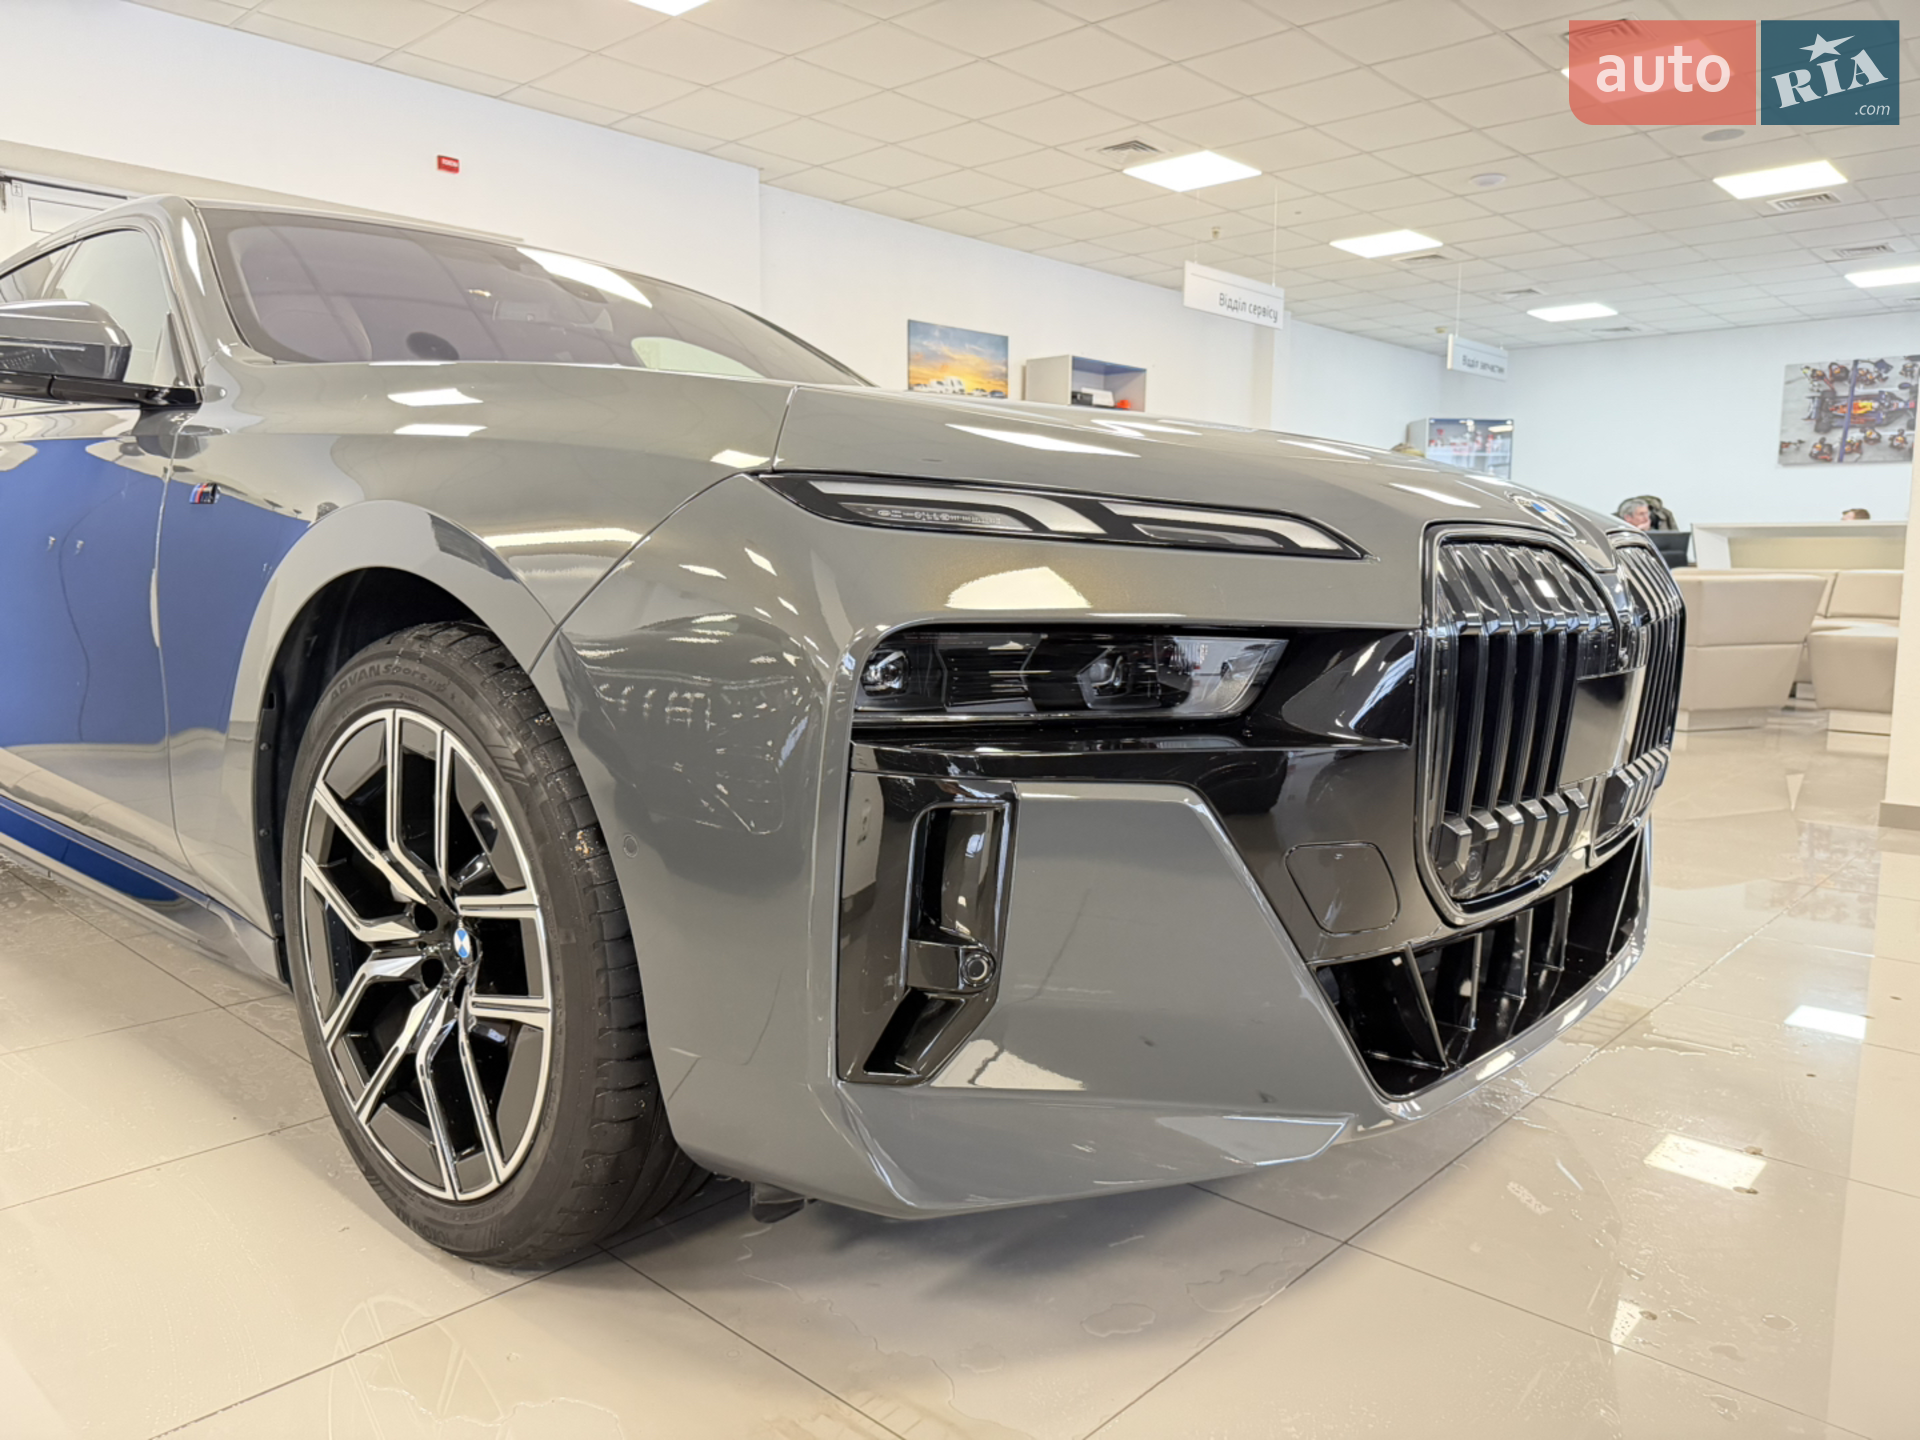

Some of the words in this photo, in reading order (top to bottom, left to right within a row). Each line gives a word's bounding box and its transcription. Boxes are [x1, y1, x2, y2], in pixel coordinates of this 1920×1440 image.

[1219, 292, 1247, 313] Відділ
[1248, 302, 1278, 323] сервісу
[330, 664, 381, 701] ADVAN
[381, 664, 428, 681] Sport
